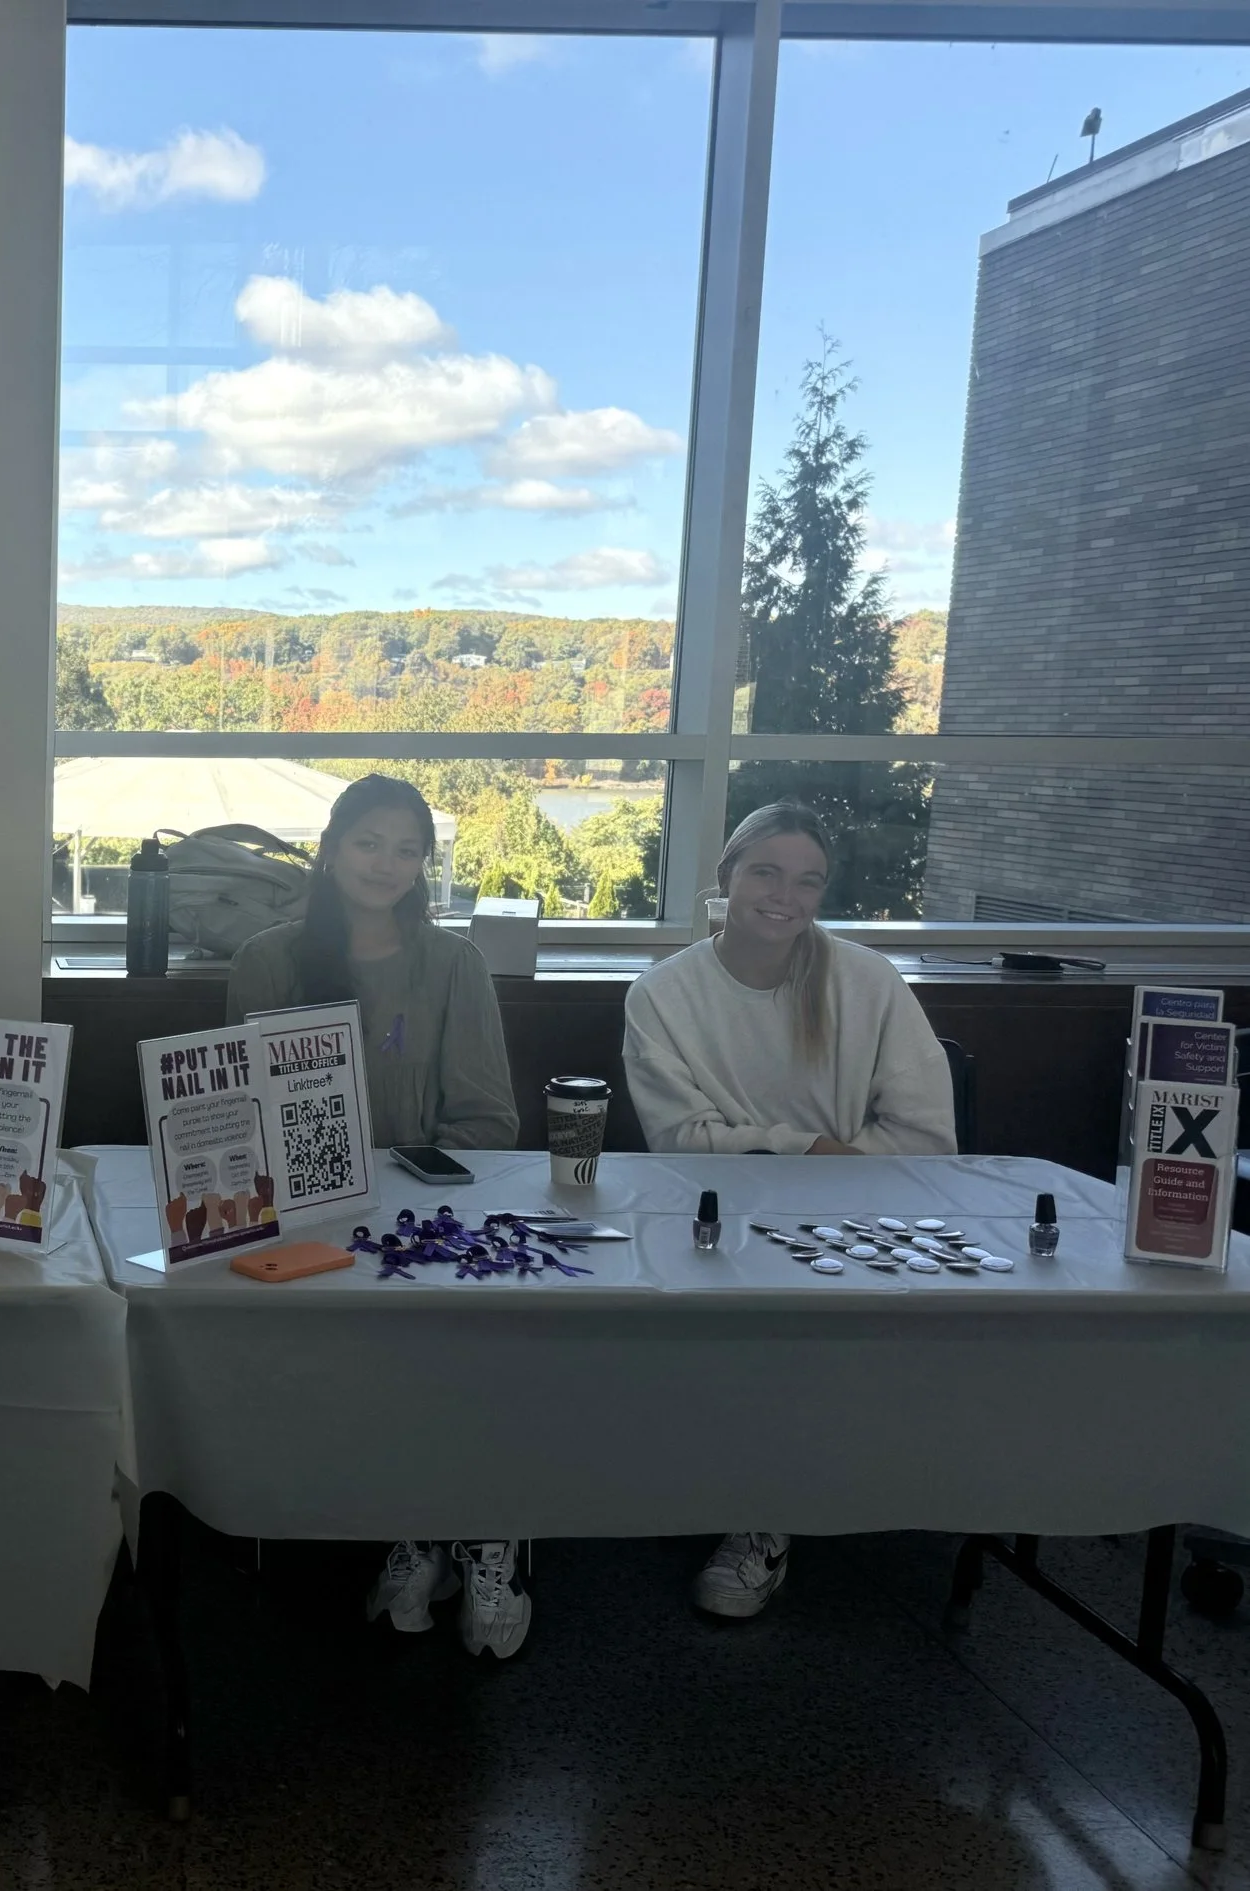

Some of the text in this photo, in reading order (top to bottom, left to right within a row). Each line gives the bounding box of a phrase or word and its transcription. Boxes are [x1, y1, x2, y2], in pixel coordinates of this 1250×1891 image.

[1161, 998, 1216, 1009] Centro para
[1166, 1008, 1215, 1019] Seguridad
[1194, 1031, 1227, 1041] Center
[4, 1033, 48, 1060] THE
[267, 1031, 345, 1065] MARIST
[1180, 1040, 1226, 1052] for Victim
[160, 1039, 249, 1075] #PUT THE
[1174, 1051, 1226, 1062] Safety and
[21, 1059, 47, 1083] IT
[278, 1057, 339, 1075] TITLE IX OFFICE
[1185, 1063, 1225, 1074] Support
[161, 1064, 250, 1100] NAIL IN IT
[1, 1101, 19, 1110] your
[1152, 1090, 1223, 1108] MARIST
[172, 1106, 190, 1116] Come
[190, 1103, 206, 1113] paint
[206, 1101, 220, 1111] your
[18, 1114, 31, 1123] the
[182, 1116, 202, 1127] purple
[210, 1112, 225, 1120] show
[225, 1109, 239, 1119] your
[174, 1127, 211, 1141] commitment
[219, 1121, 241, 1132] putting
[241, 1119, 251, 1127] the
[1150, 1105, 1166, 1153] TITLE IX
[1165, 1106, 1221, 1159] X
[179, 1143, 190, 1151] nail
[196, 1137, 223, 1148] domestic
[1157, 1163, 1205, 1176] Resource
[1153, 1176, 1206, 1189] Guide and
[1148, 1187, 1208, 1202] Information
